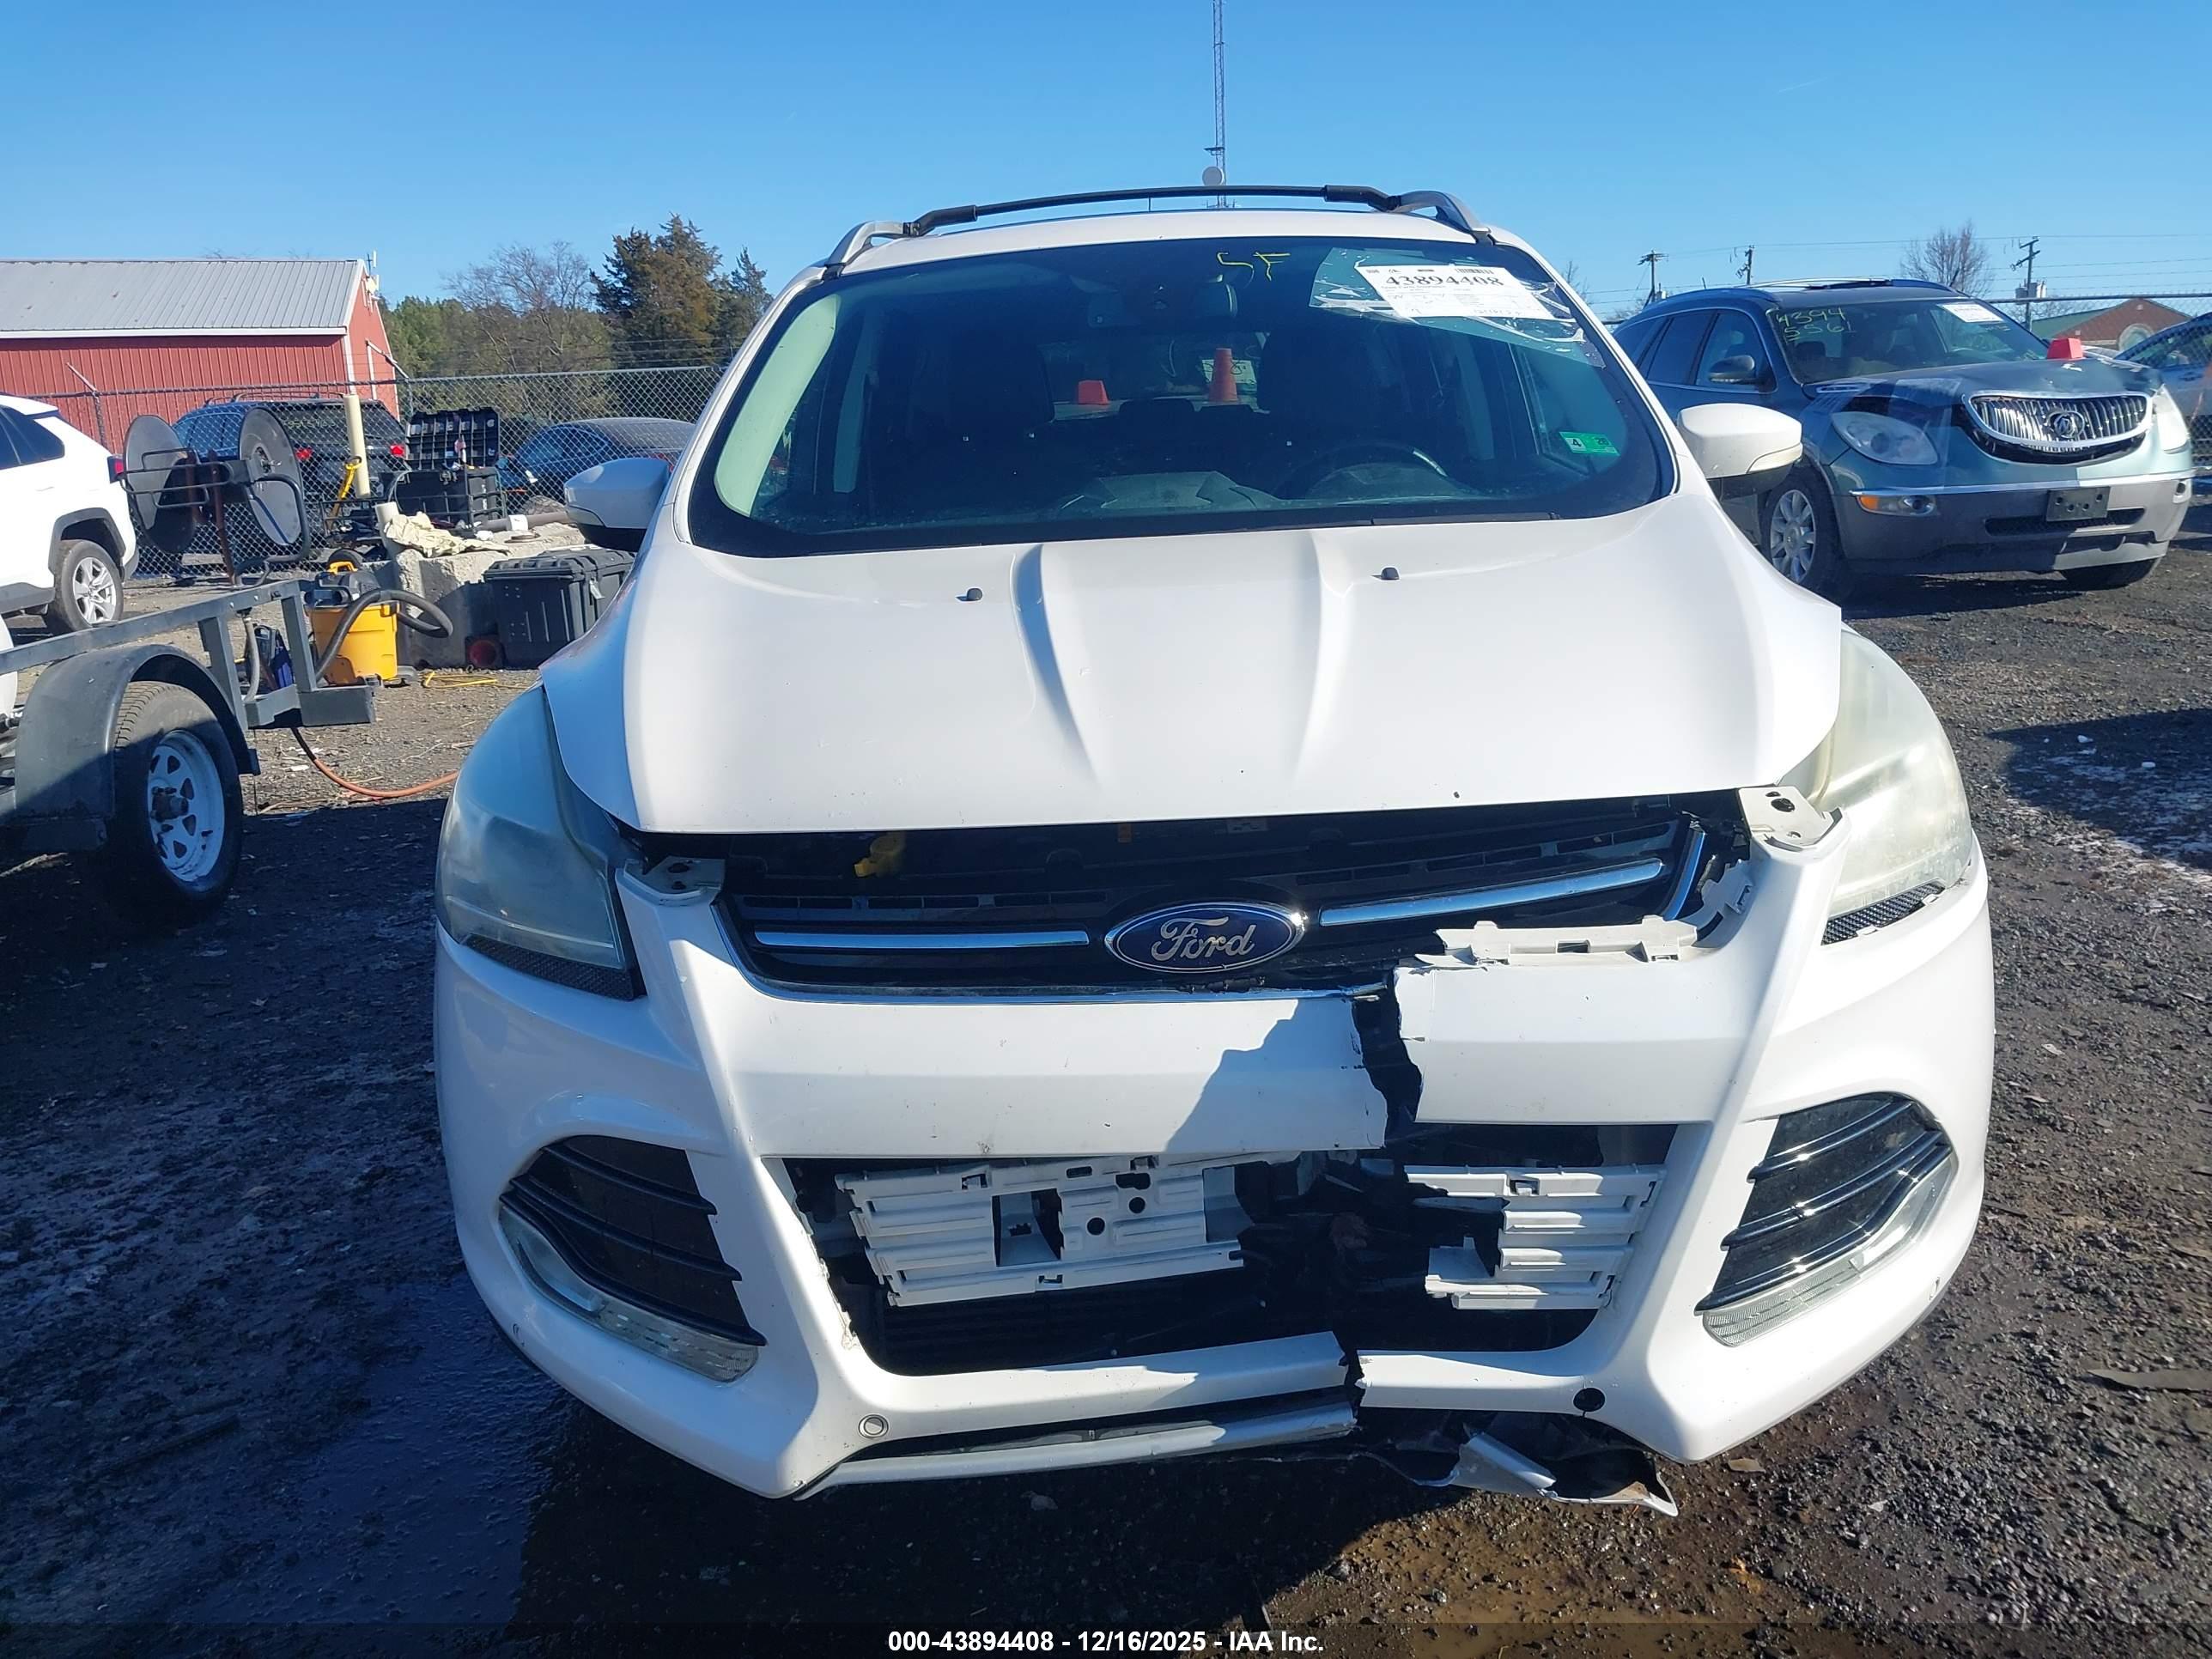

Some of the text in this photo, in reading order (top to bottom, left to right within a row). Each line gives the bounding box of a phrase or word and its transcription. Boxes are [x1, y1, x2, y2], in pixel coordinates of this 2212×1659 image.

[1385, 275, 1505, 287] 43894408
[1776, 307, 1845, 326] 4394
[1151, 916, 1256, 962] Ford
